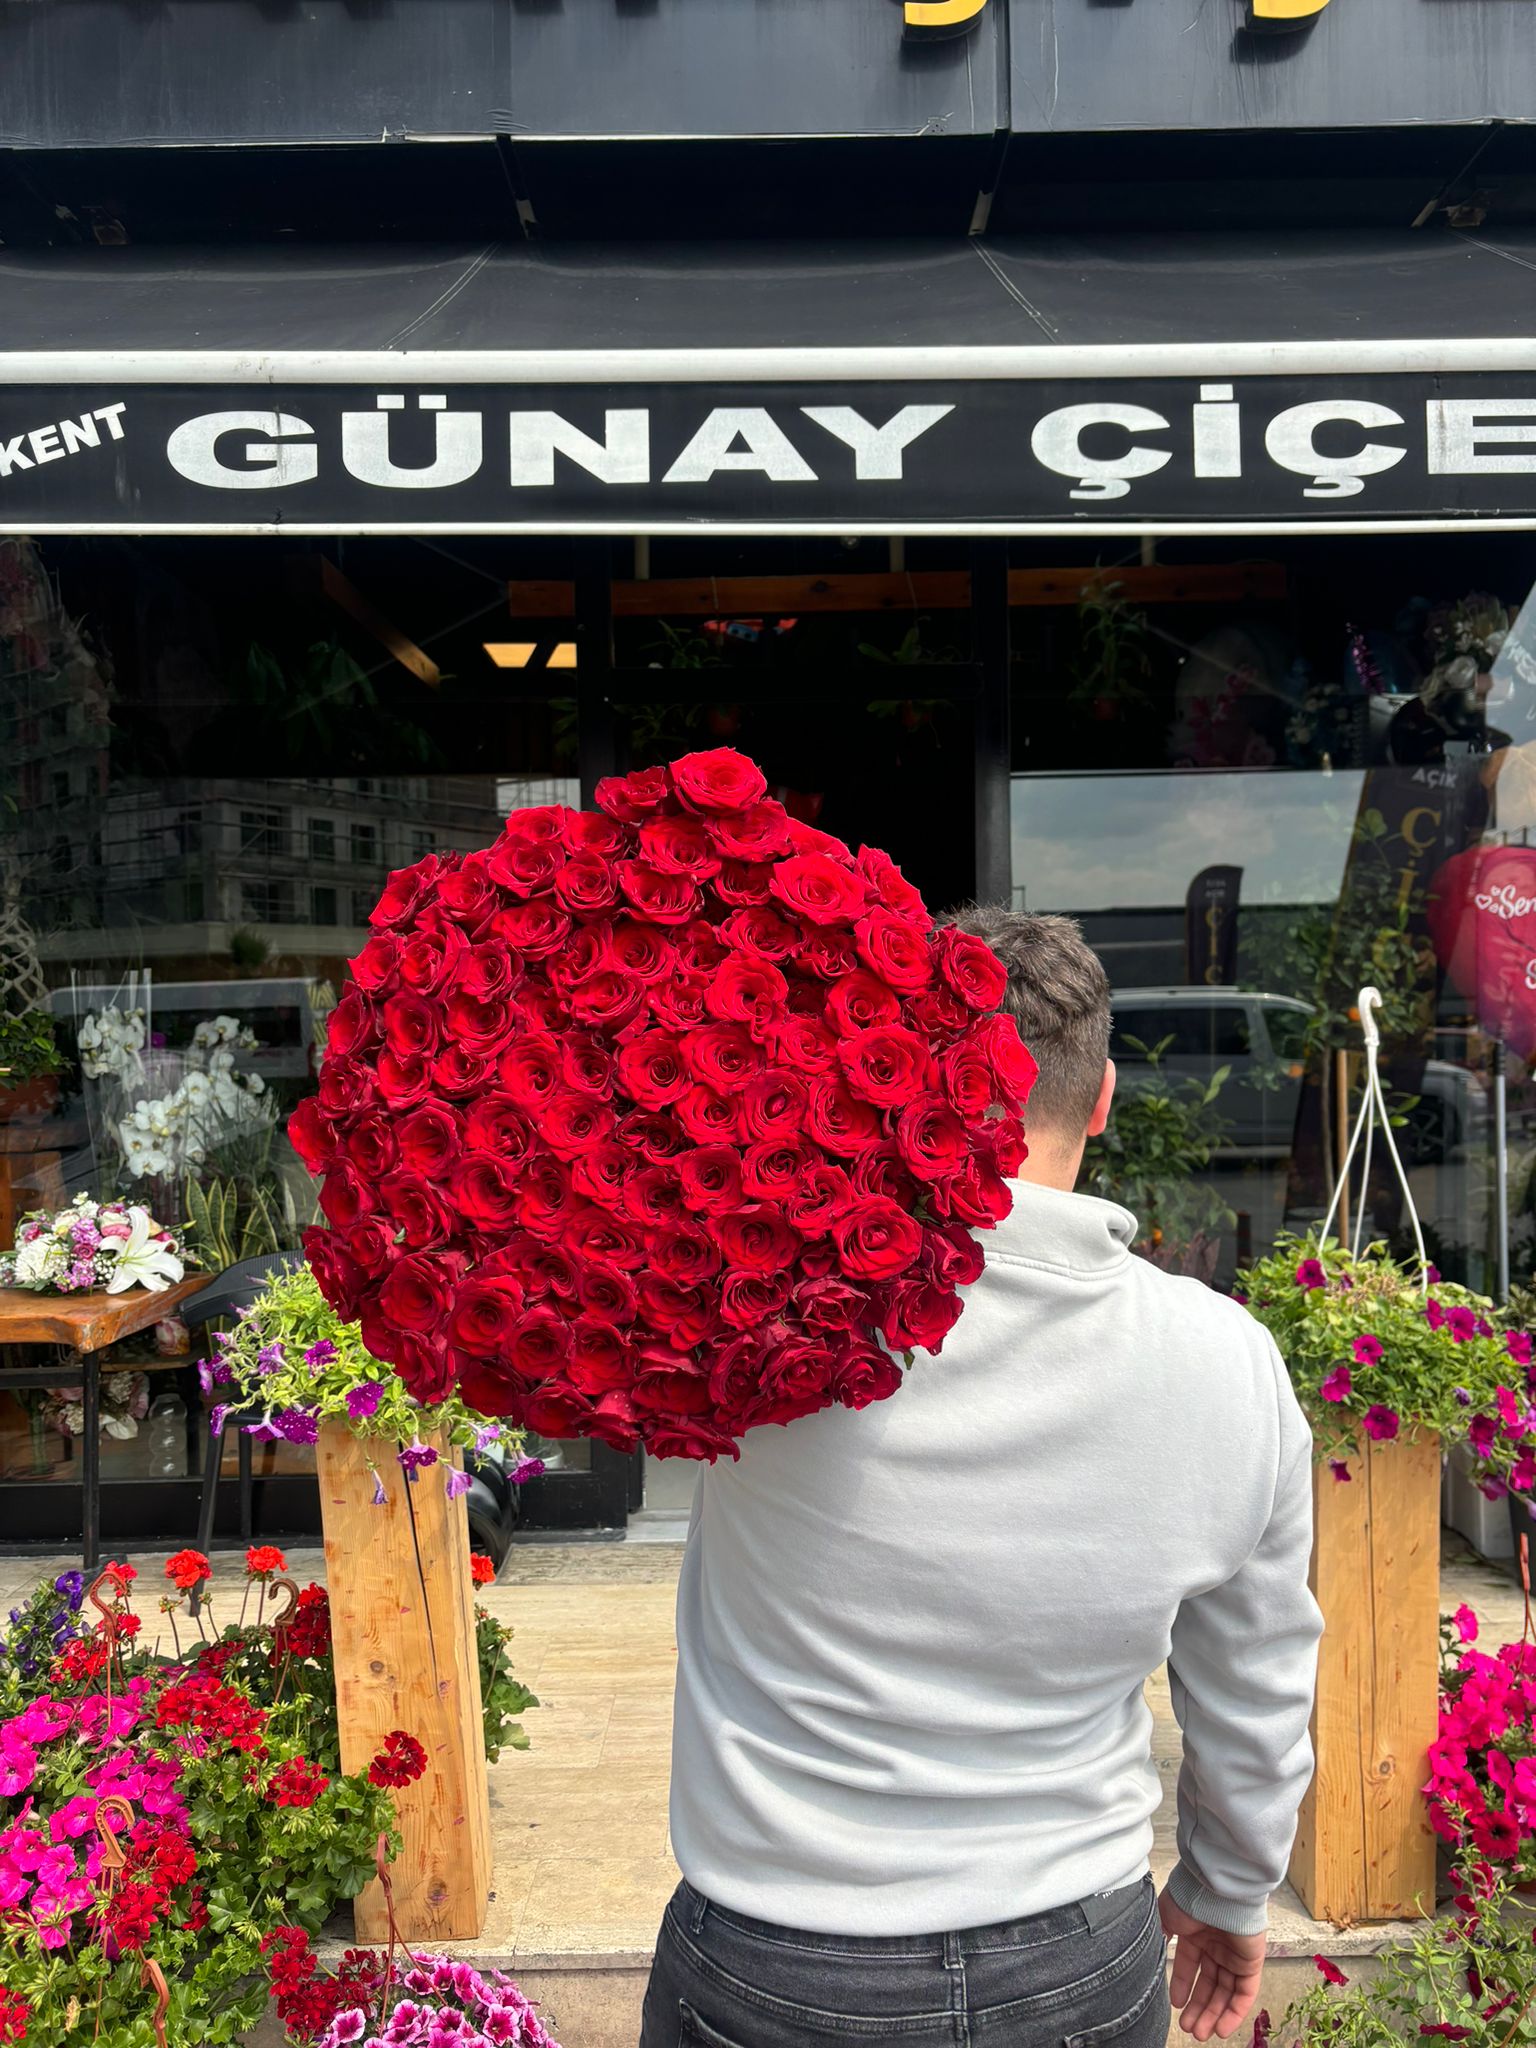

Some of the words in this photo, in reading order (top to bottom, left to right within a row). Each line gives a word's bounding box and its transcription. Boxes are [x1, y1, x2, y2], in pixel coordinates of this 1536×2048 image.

[0, 401, 127, 477] KENT
[166, 394, 956, 490] GÜNAY
[1030, 383, 1536, 499] ÇİÇE
